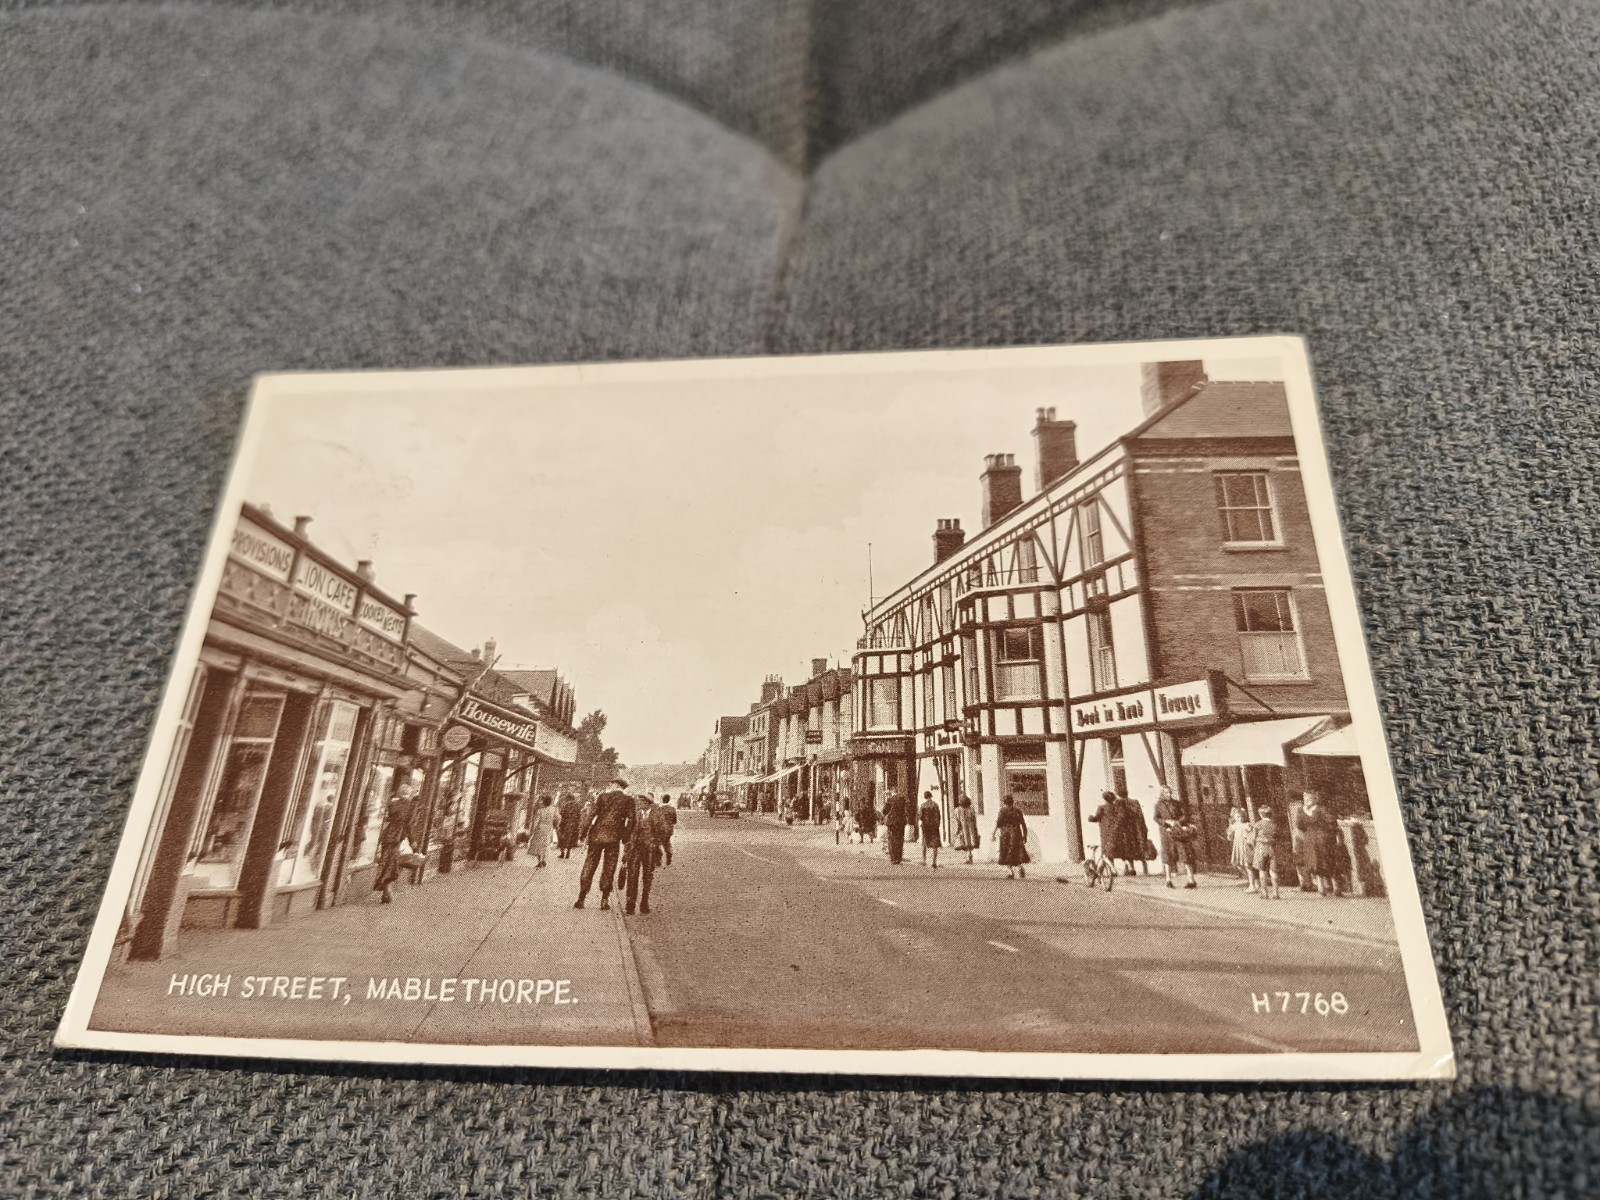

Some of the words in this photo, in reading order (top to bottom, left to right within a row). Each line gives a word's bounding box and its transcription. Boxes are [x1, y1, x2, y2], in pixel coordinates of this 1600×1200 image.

[326, 577, 355, 609] CAFE
[461, 700, 535, 742] Housewife
[167, 973, 232, 997] HIGH
[240, 975, 352, 1006] STREET,
[366, 977, 580, 1004] MABLETHORPE.
[1250, 990, 1350, 1016] H7768
